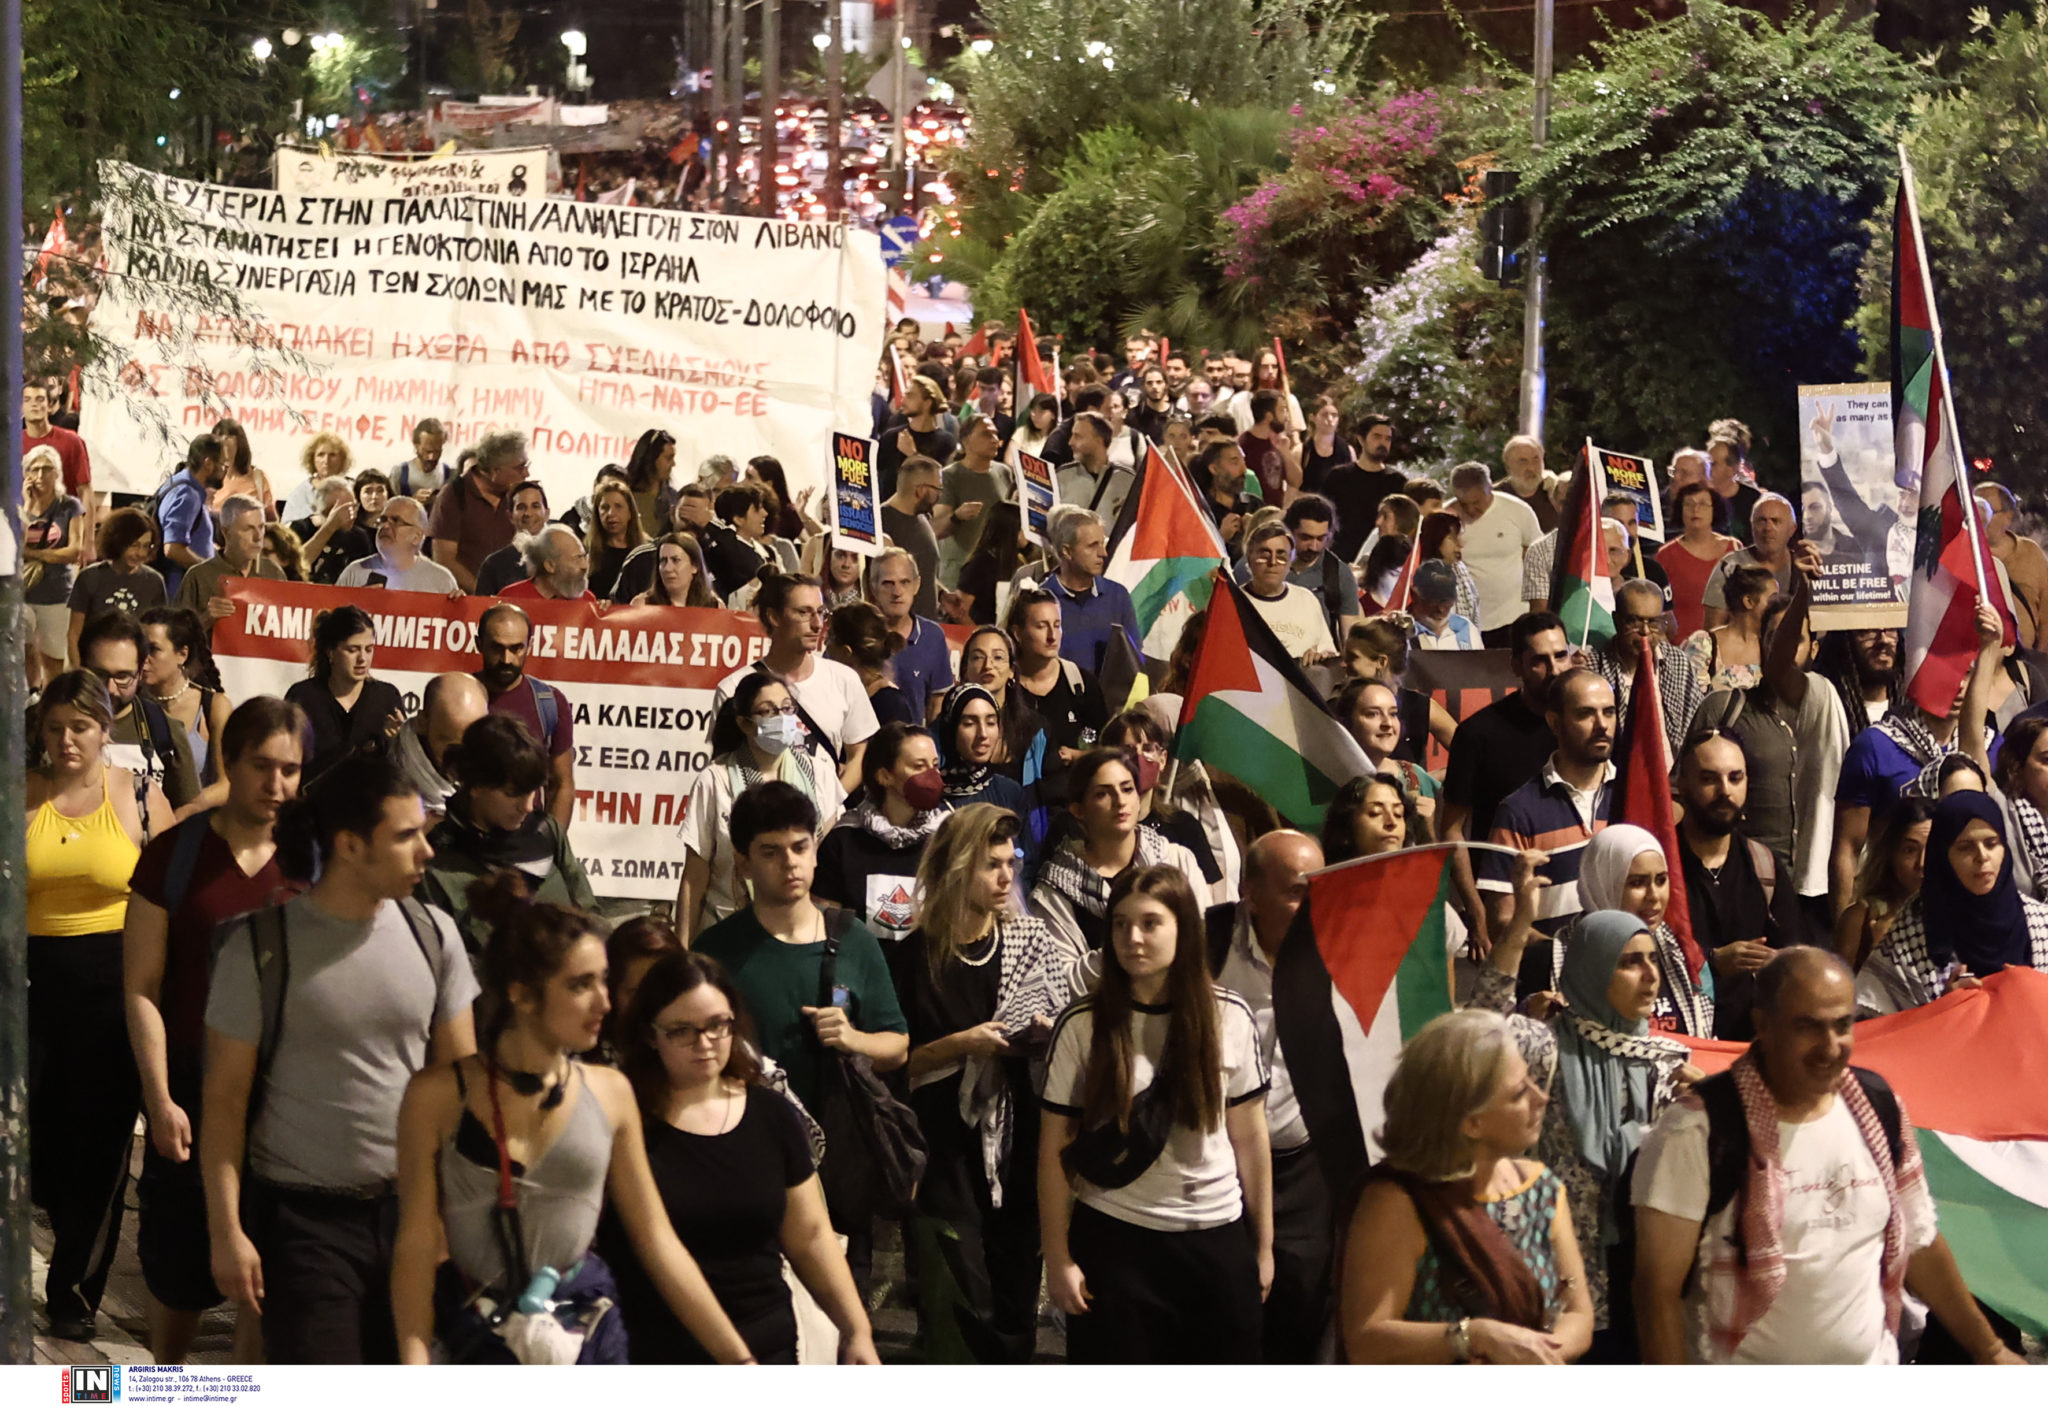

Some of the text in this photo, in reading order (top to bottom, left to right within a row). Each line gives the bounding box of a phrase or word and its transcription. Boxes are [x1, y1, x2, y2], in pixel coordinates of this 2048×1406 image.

[296, 196, 373, 226] ΣΤΗΝ
[688, 217, 739, 244] ΣΤΟΝ
[754, 221, 844, 250] ΛΙΒΑΝΟ
[131, 213, 700, 284] ΝΑ ΣΤΑΜΑΤΗΣΕΙ Η ΓΕΝΟΚΤΟΝΙΑ ΑΠΟ ΤΟ ΙΣΡΑΗΛ
[127, 247, 211, 286] ΚΑΜΙΑ
[214, 260, 356, 297] ΣΥΝΕΡΓΑΣΙΑ
[368, 269, 418, 294] ΤΩΝ
[425, 272, 516, 306] ΣΧΟΛΩΝ
[522, 280, 568, 310] ΜΑΣ
[578, 287, 614, 313] ΜΕ
[620, 289, 646, 315] ΤΟ
[134, 309, 173, 340] ΝΑ
[392, 331, 411, 358] Η
[416, 332, 488, 364] ΧΩΡΑ
[511, 339, 570, 368] ΑΠΟ
[585, 342, 772, 391] ΣΧΕΔΙΑΣΜΟΥΣ
[578, 376, 768, 418] ΗΠΑ-ΝΑΤΟ-ΕΕ
[1847, 400, 1888, 411] They can
[1836, 412, 1888, 423] as many as
[839, 437, 864, 460] NO
[837, 456, 869, 477] MORE
[1607, 454, 1637, 473] NO
[842, 470, 867, 487] FUEL
[1606, 465, 1645, 483] MORE
[1613, 473, 1644, 489] FUEL
[1819, 563, 1872, 575] ALESTINE
[1812, 576, 1887, 590] WILL BE FREE
[1812, 592, 1839, 602] within
[1856, 590, 1891, 600] lifetime!
[563, 626, 685, 665] ΕΛΛΑΔΑΣ
[689, 633, 742, 669] ΣΤΟ
[599, 747, 650, 770] ΕΞΩ
[655, 750, 709, 773] ΑΠΟ
